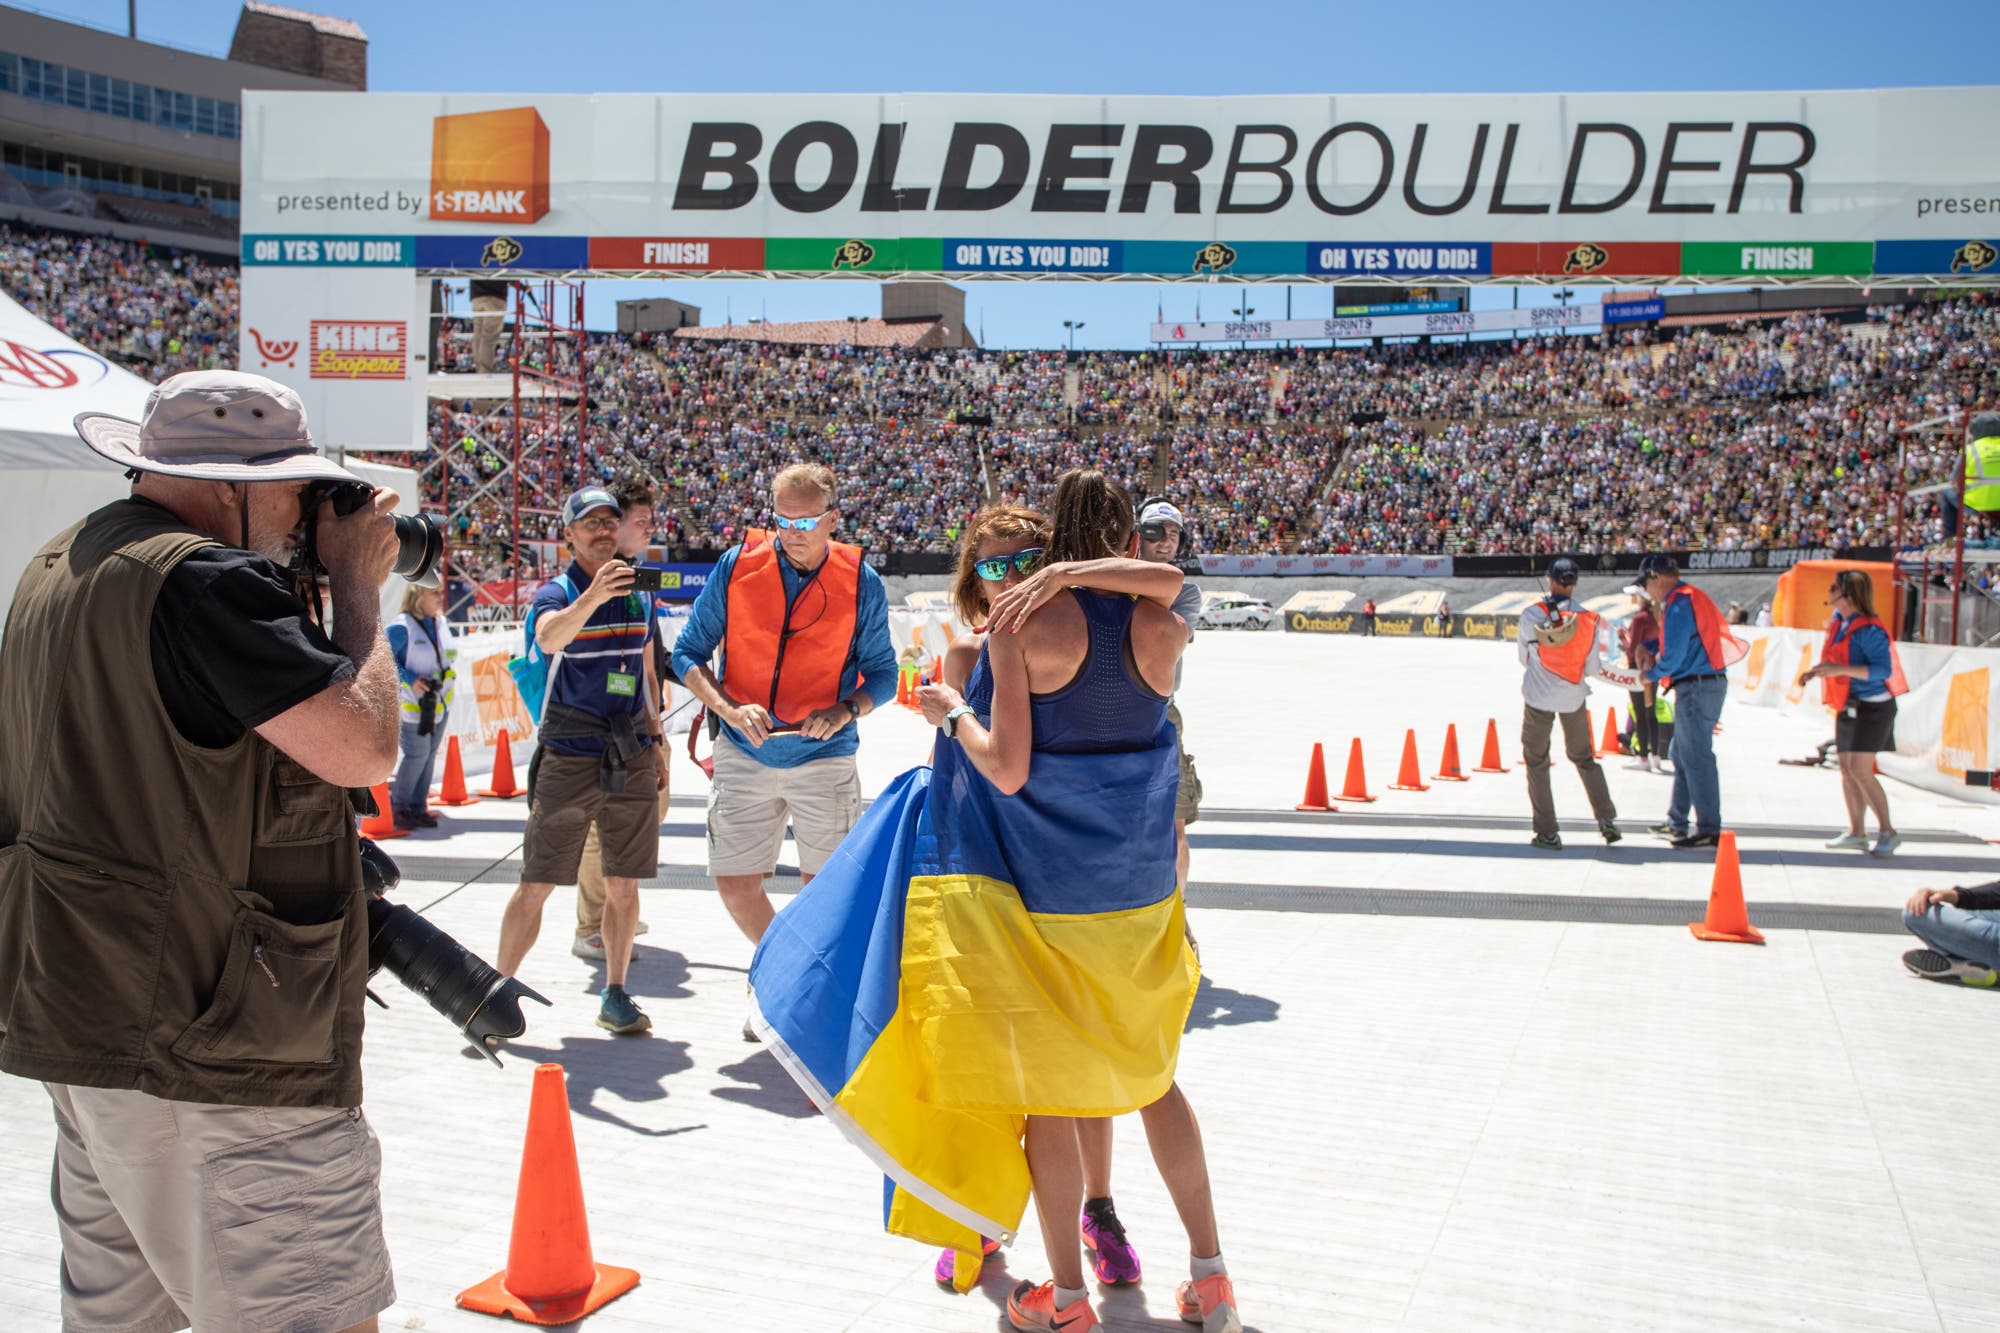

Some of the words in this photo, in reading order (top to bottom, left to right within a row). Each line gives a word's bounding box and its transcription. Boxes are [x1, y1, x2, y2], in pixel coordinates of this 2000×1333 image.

[278, 191, 389, 214] presented
[398, 190, 422, 214] by
[1917, 196, 2000, 218] presen
[254, 240, 279, 260] OH
[284, 241, 318, 261] YES
[323, 241, 360, 262] YOU
[363, 242, 401, 262] DID!
[643, 242, 709, 264] FINISH
[956, 245, 982, 266] OH
[987, 245, 1024, 266] YES
[1028, 246, 1066, 267] YOU
[1070, 247, 1109, 267] DID!
[1320, 248, 1346, 269] OH
[1351, 248, 1389, 269] YES
[1394, 248, 1432, 269] YOU
[1437, 249, 1477, 269] DID!
[1741, 247, 1813, 270] FINISH
[1425, 313, 1475, 327] SPRINTS
[1530, 305, 1582, 320] SPRINTS
[1225, 322, 1272, 335] SPRINTS
[1324, 318, 1372, 331] SPRINTS
[316, 326, 401, 351] KING
[315, 350, 402, 376] Soopers
[1688, 553, 1751, 569] COLORADO
